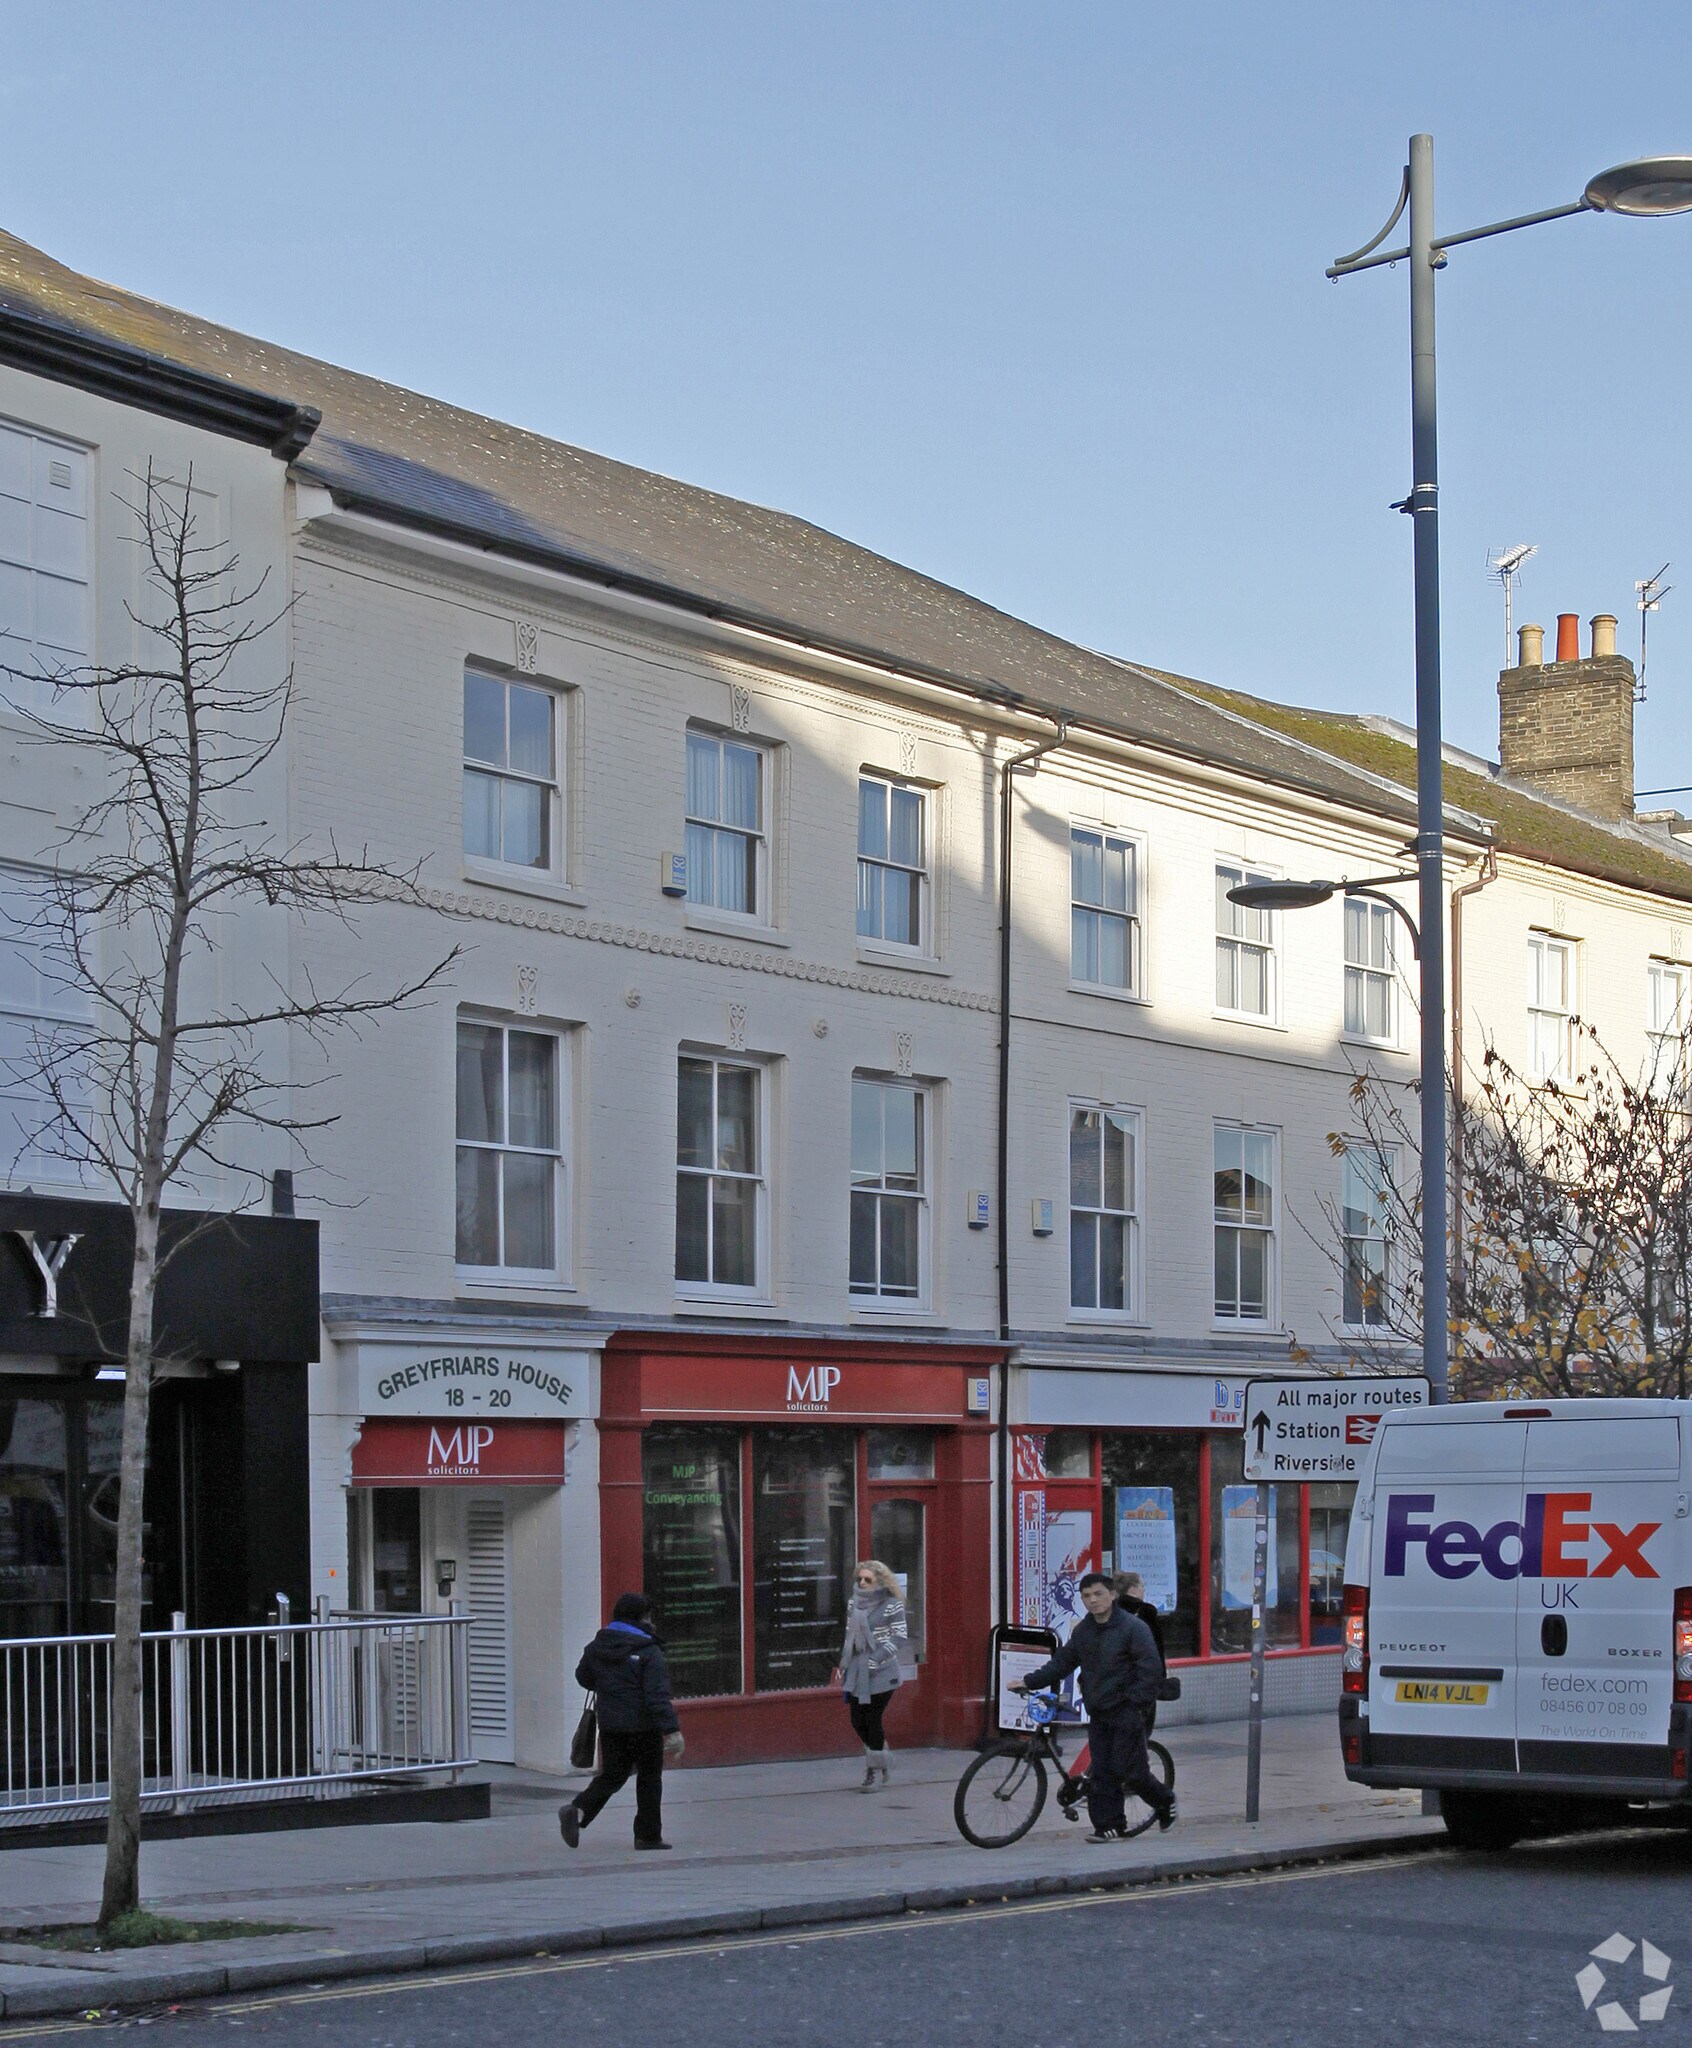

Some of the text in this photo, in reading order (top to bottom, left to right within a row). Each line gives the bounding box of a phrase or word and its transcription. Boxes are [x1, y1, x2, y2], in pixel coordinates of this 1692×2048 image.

[378, 1357, 572, 1405] GREYFRIARS HOUSE
[786, 1365, 841, 1402] MJP
[445, 1389, 464, 1406] 18
[489, 1390, 511, 1407] 20
[786, 1402, 828, 1411] solicitors
[1277, 1388, 1422, 1408] All major routes
[1276, 1422, 1340, 1439] Station
[428, 1425, 494, 1464] MJP
[428, 1465, 480, 1475] solicitors
[1274, 1454, 1355, 1471] Riverside
[672, 1464, 696, 1479] MJP
[645, 1491, 722, 1507] Conveyancing
[1384, 1492, 1663, 1580] FedEx
[1541, 1583, 1579, 1608] UK
[1379, 1643, 1447, 1652] PEUGEOT
[1608, 1648, 1663, 1657] BOXER
[1541, 1672, 1648, 1693] fedex.com
[1403, 1684, 1475, 1701] LN14 VJL
[1540, 1699, 1648, 1716] 08456 07 08 09
[1541, 1725, 1648, 1739] The World On Time
